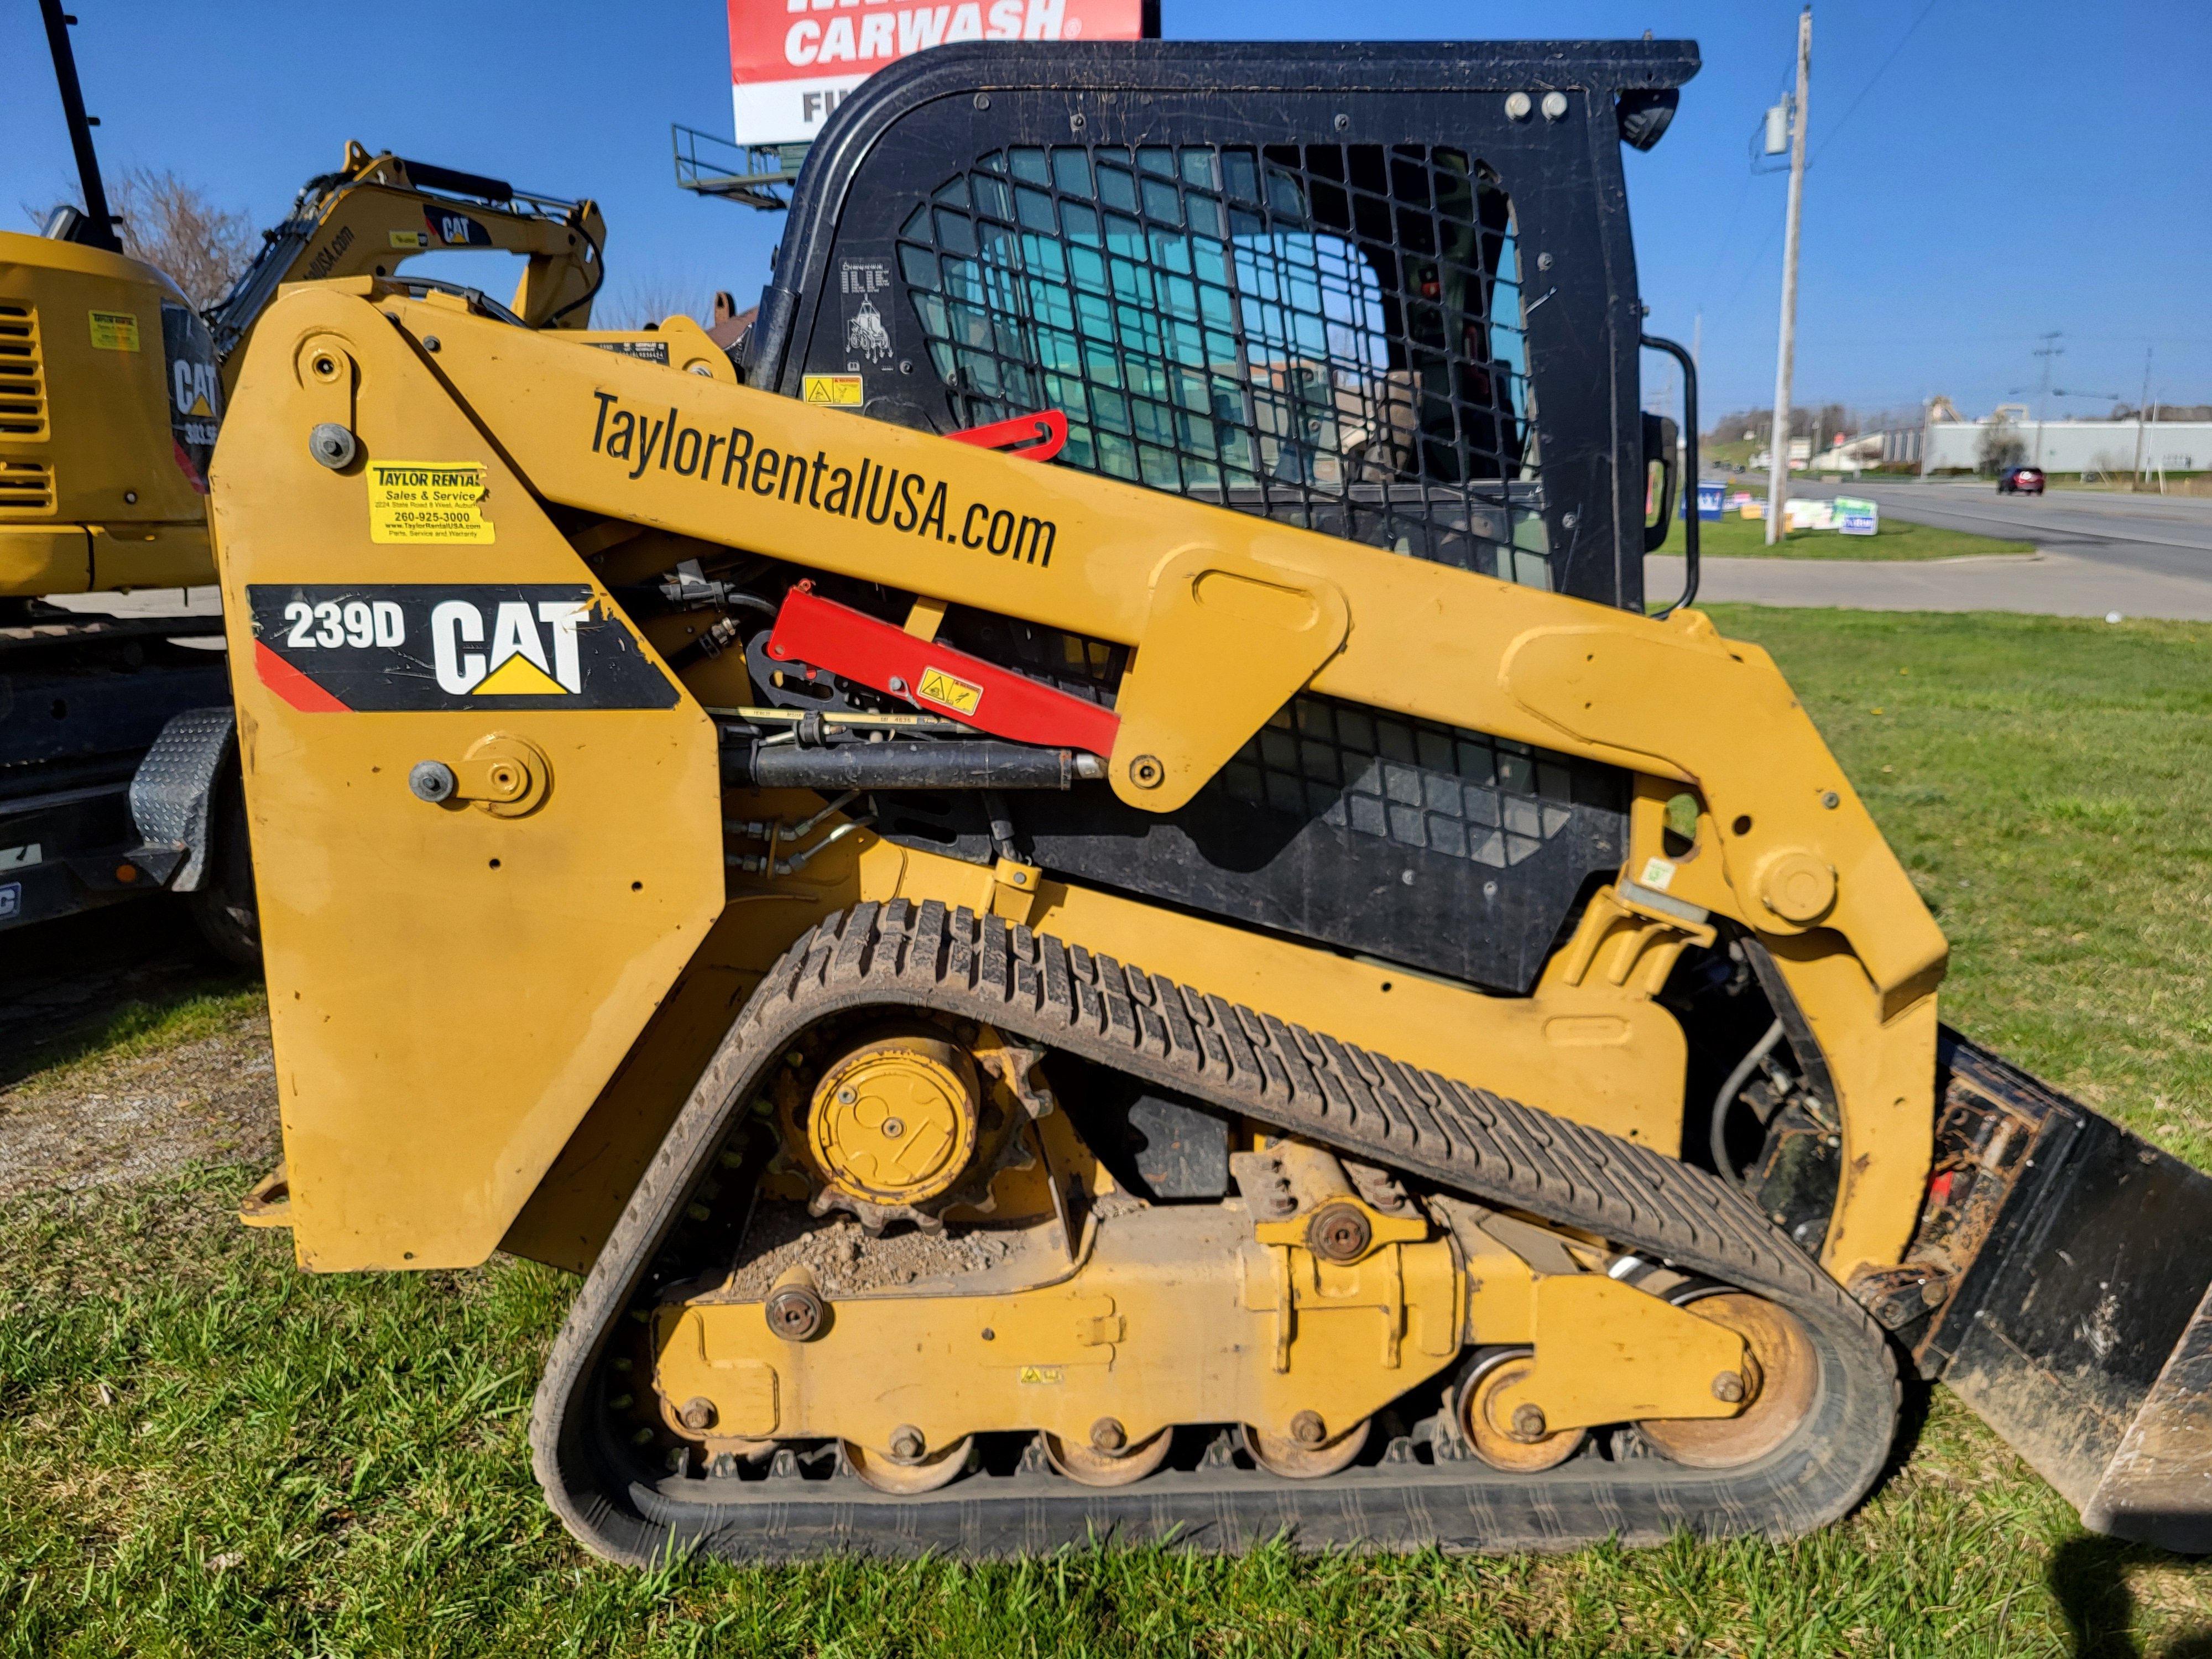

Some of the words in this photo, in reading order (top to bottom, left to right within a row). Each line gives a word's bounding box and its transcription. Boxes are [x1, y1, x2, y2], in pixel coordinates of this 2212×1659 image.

[442, 217, 470, 244] CAT
[174, 359, 216, 415] CAT
[379, 469, 428, 486] TAYLOR
[386, 491, 416, 500] Sales
[421, 492, 429, 500] &
[433, 491, 476, 501] Service
[591, 391, 1057, 568] TaylorRentalUSA.com
[395, 512, 470, 521] 260-925-3000
[285, 601, 405, 648] 239D
[431, 600, 590, 695] CAT
